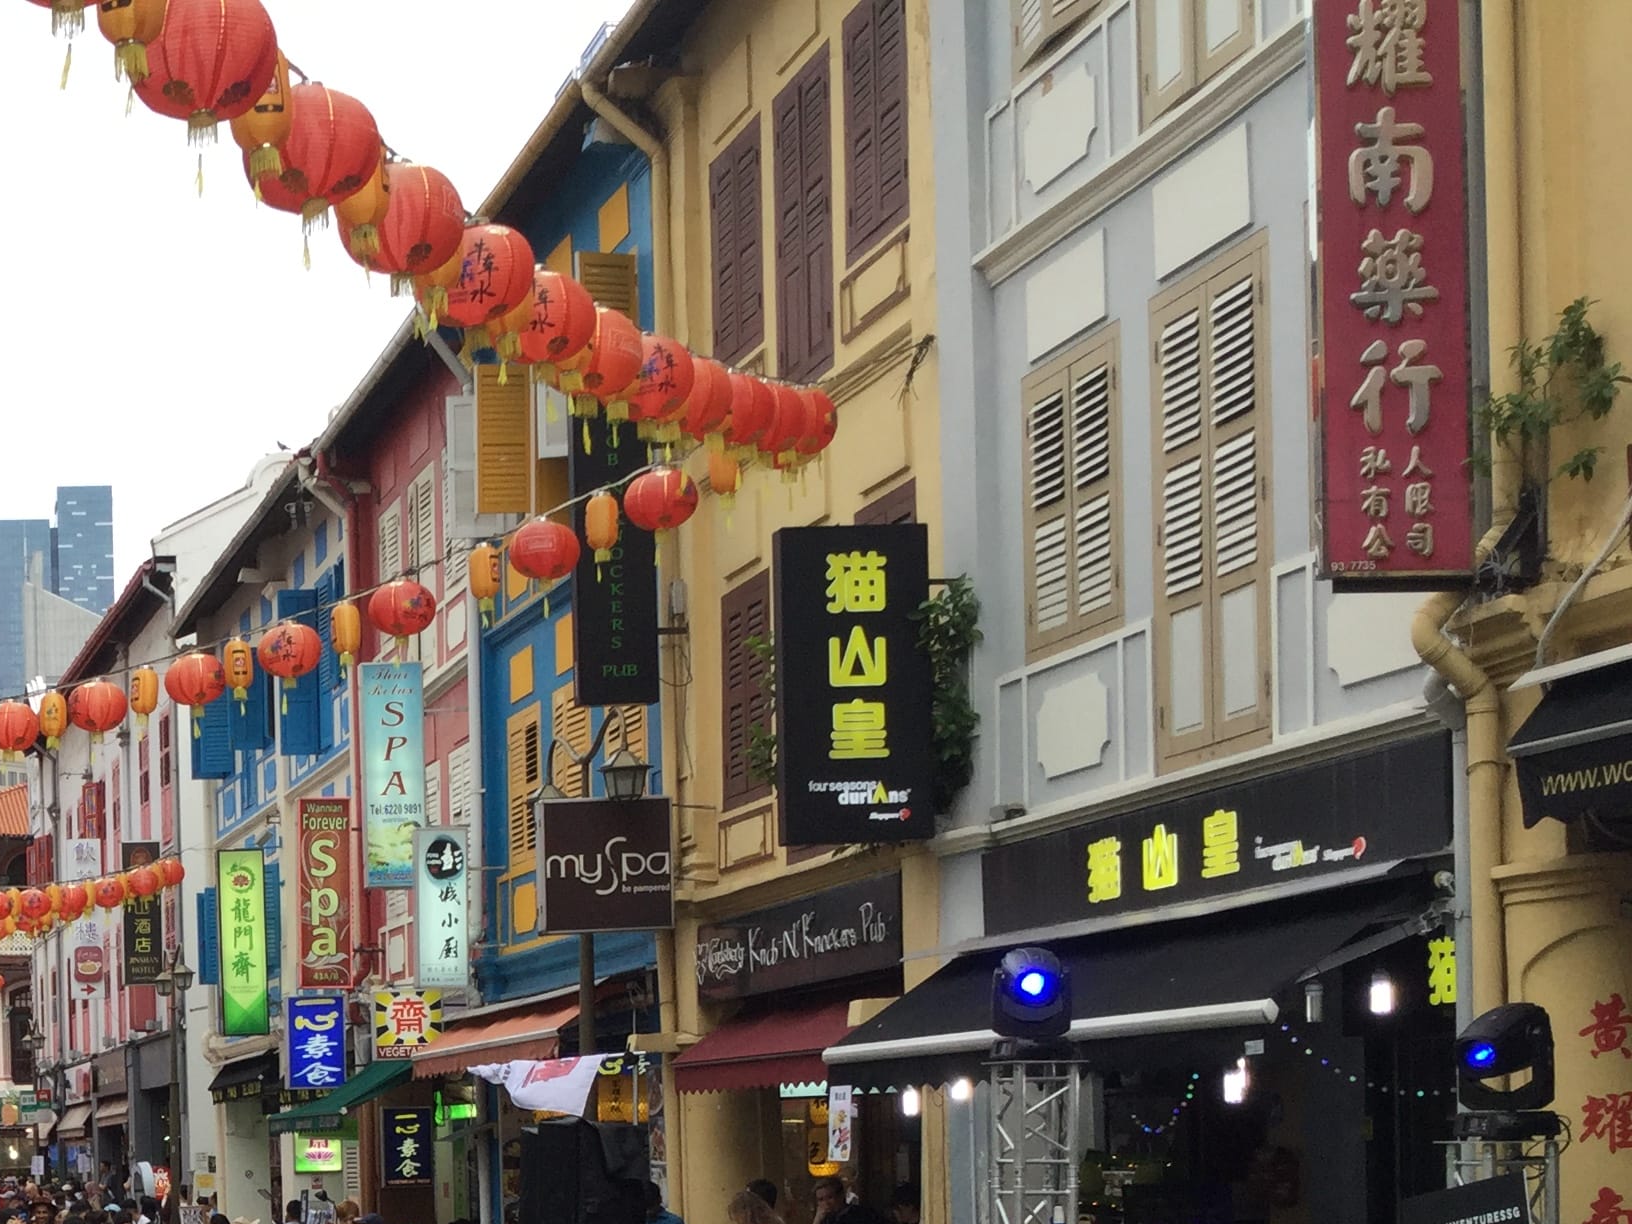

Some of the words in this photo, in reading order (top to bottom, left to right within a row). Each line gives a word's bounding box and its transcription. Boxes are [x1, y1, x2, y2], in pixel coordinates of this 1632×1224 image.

[602, 664, 638, 677] PUB
[825, 550, 890, 760] 猫山皇
[381, 702, 407, 796] SPA
[302, 814, 348, 831] Forever
[306, 803, 343, 814] Wannian
[1087, 810, 1239, 903] 猫山皇
[74, 841, 99, 942] 飲樓
[310, 838, 339, 956] Spa
[859, 902, 886, 943] Pub
[131, 965, 155, 973] HOTEL
[379, 1045, 422, 1058] VEGETA
